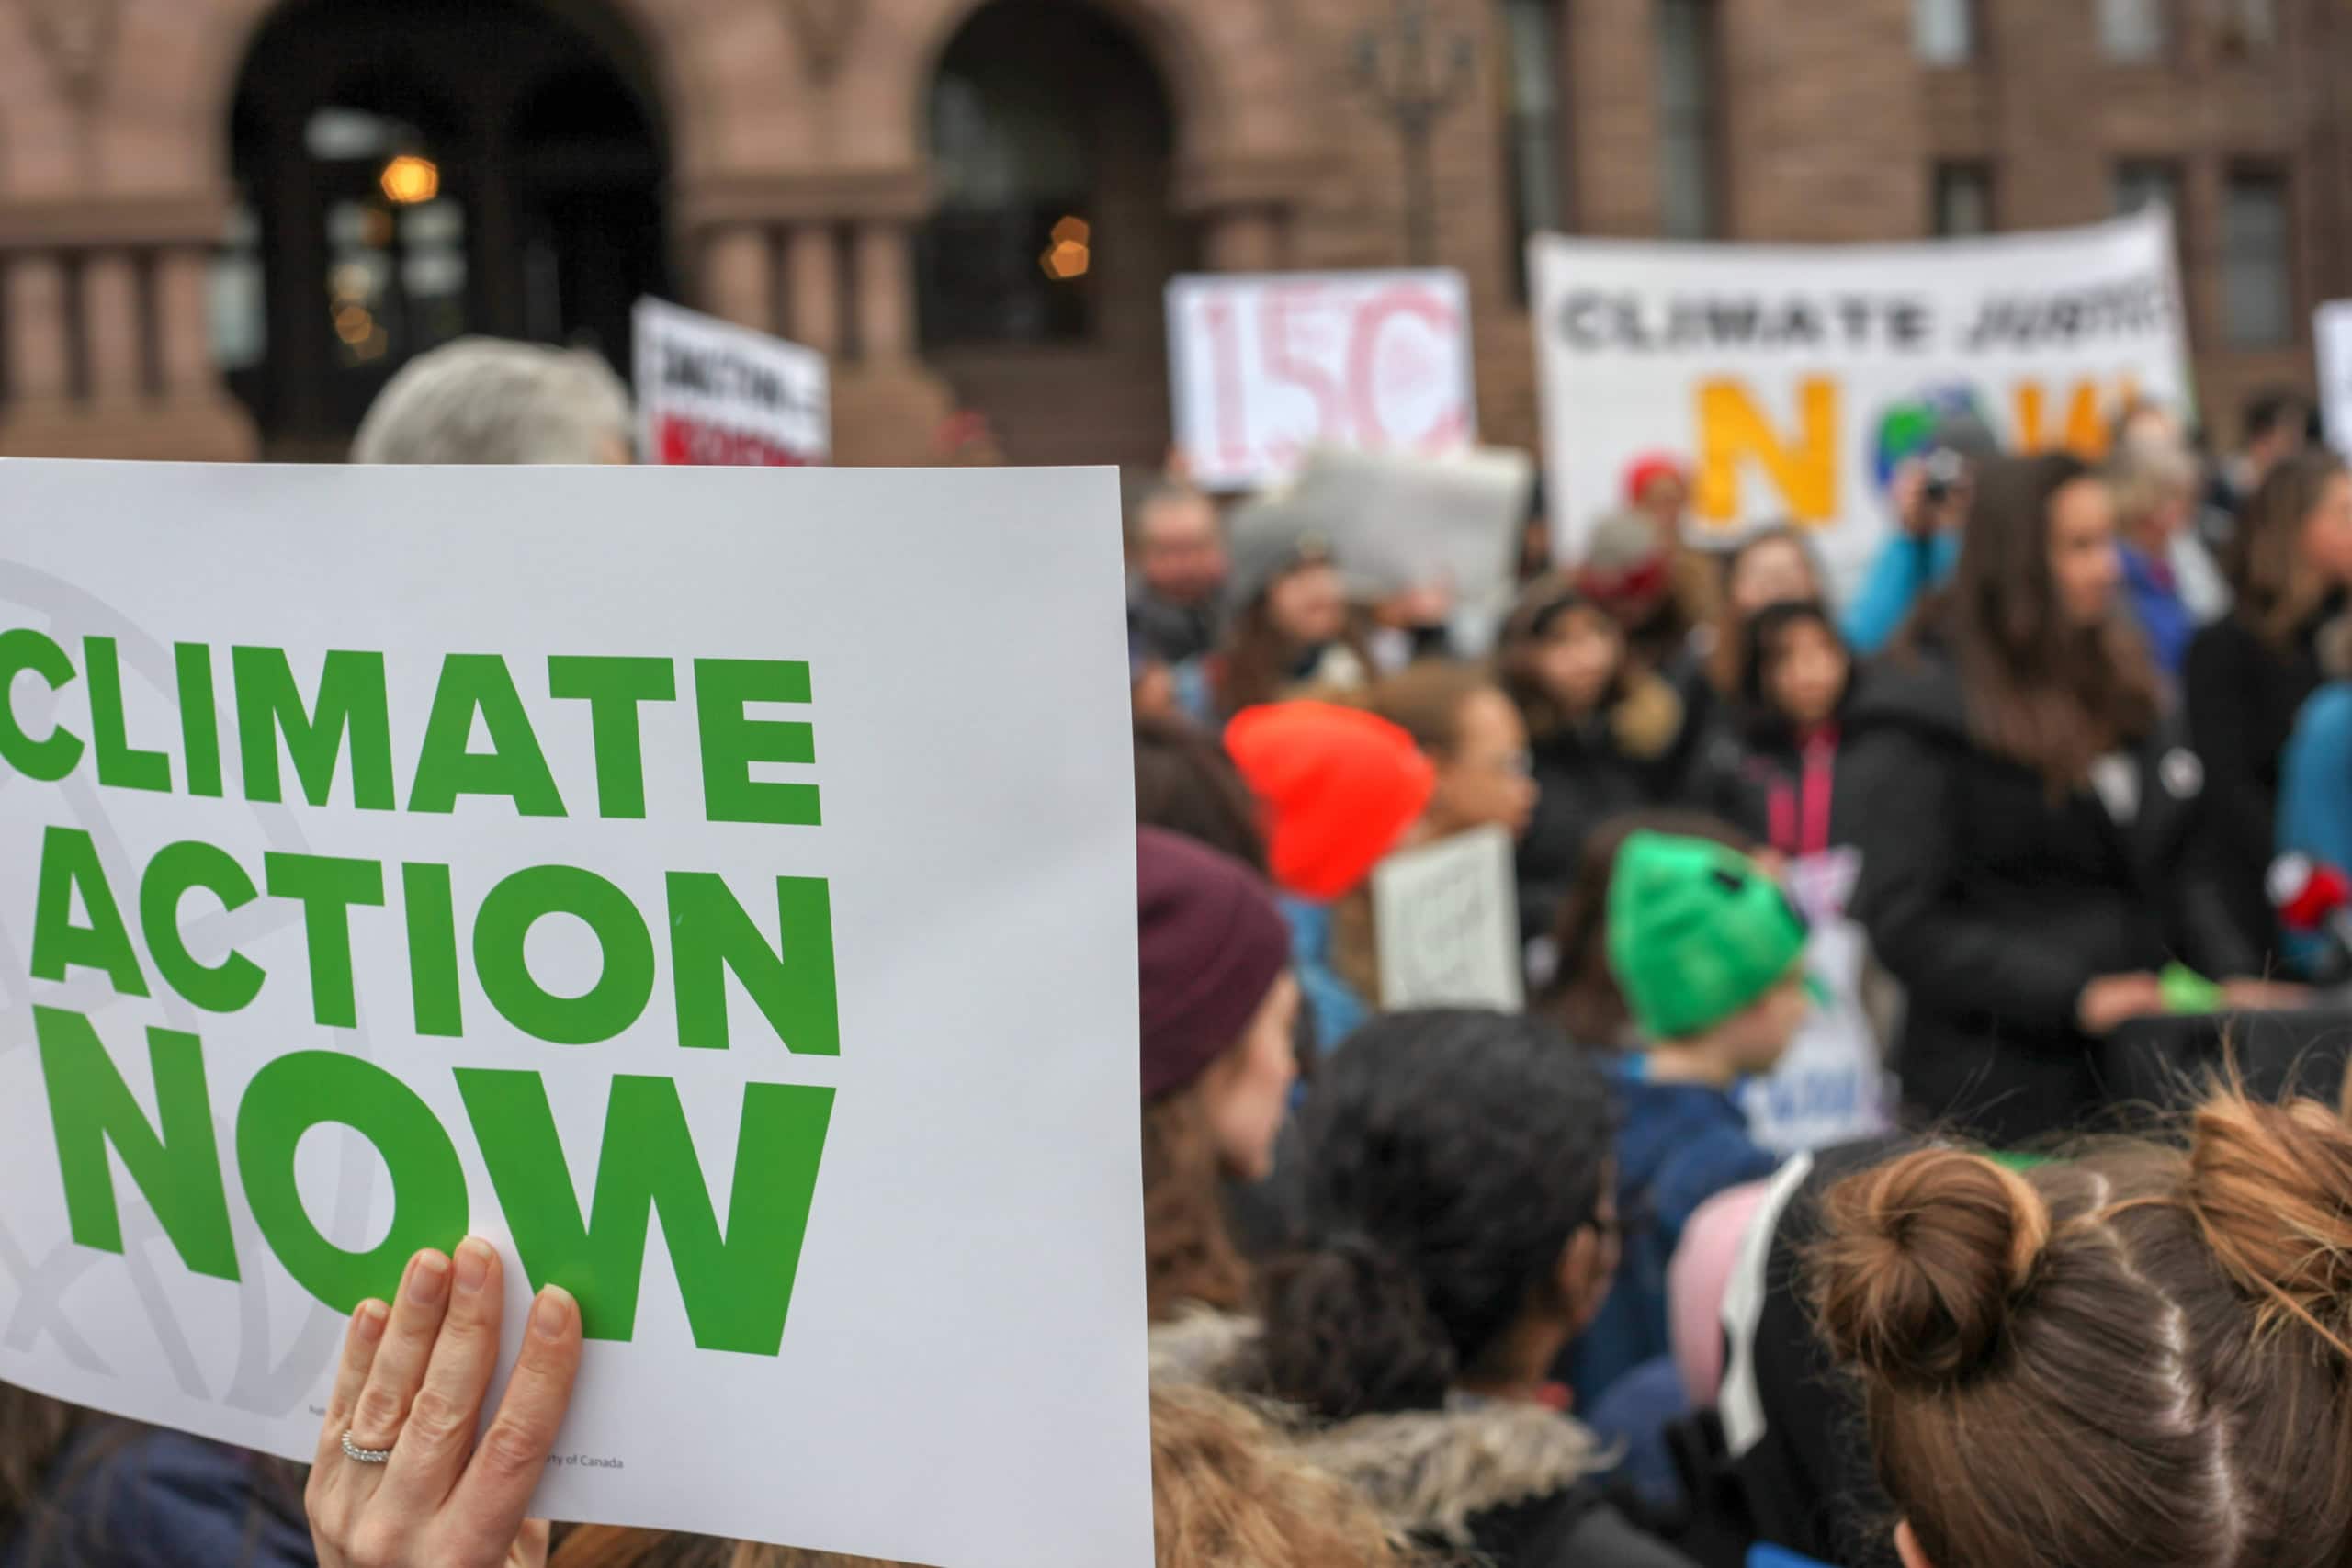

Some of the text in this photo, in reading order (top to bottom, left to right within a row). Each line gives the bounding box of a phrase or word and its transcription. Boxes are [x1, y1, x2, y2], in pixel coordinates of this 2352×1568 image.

[1557, 286, 1930, 355] CLIMATE
[0, 629, 822, 825] CLIMATE
[32, 826, 840, 1056] ACTION
[34, 1006, 835, 1356] NOW
[566, 1454, 578, 1465] of
[580, 1455, 624, 1469] Canada
